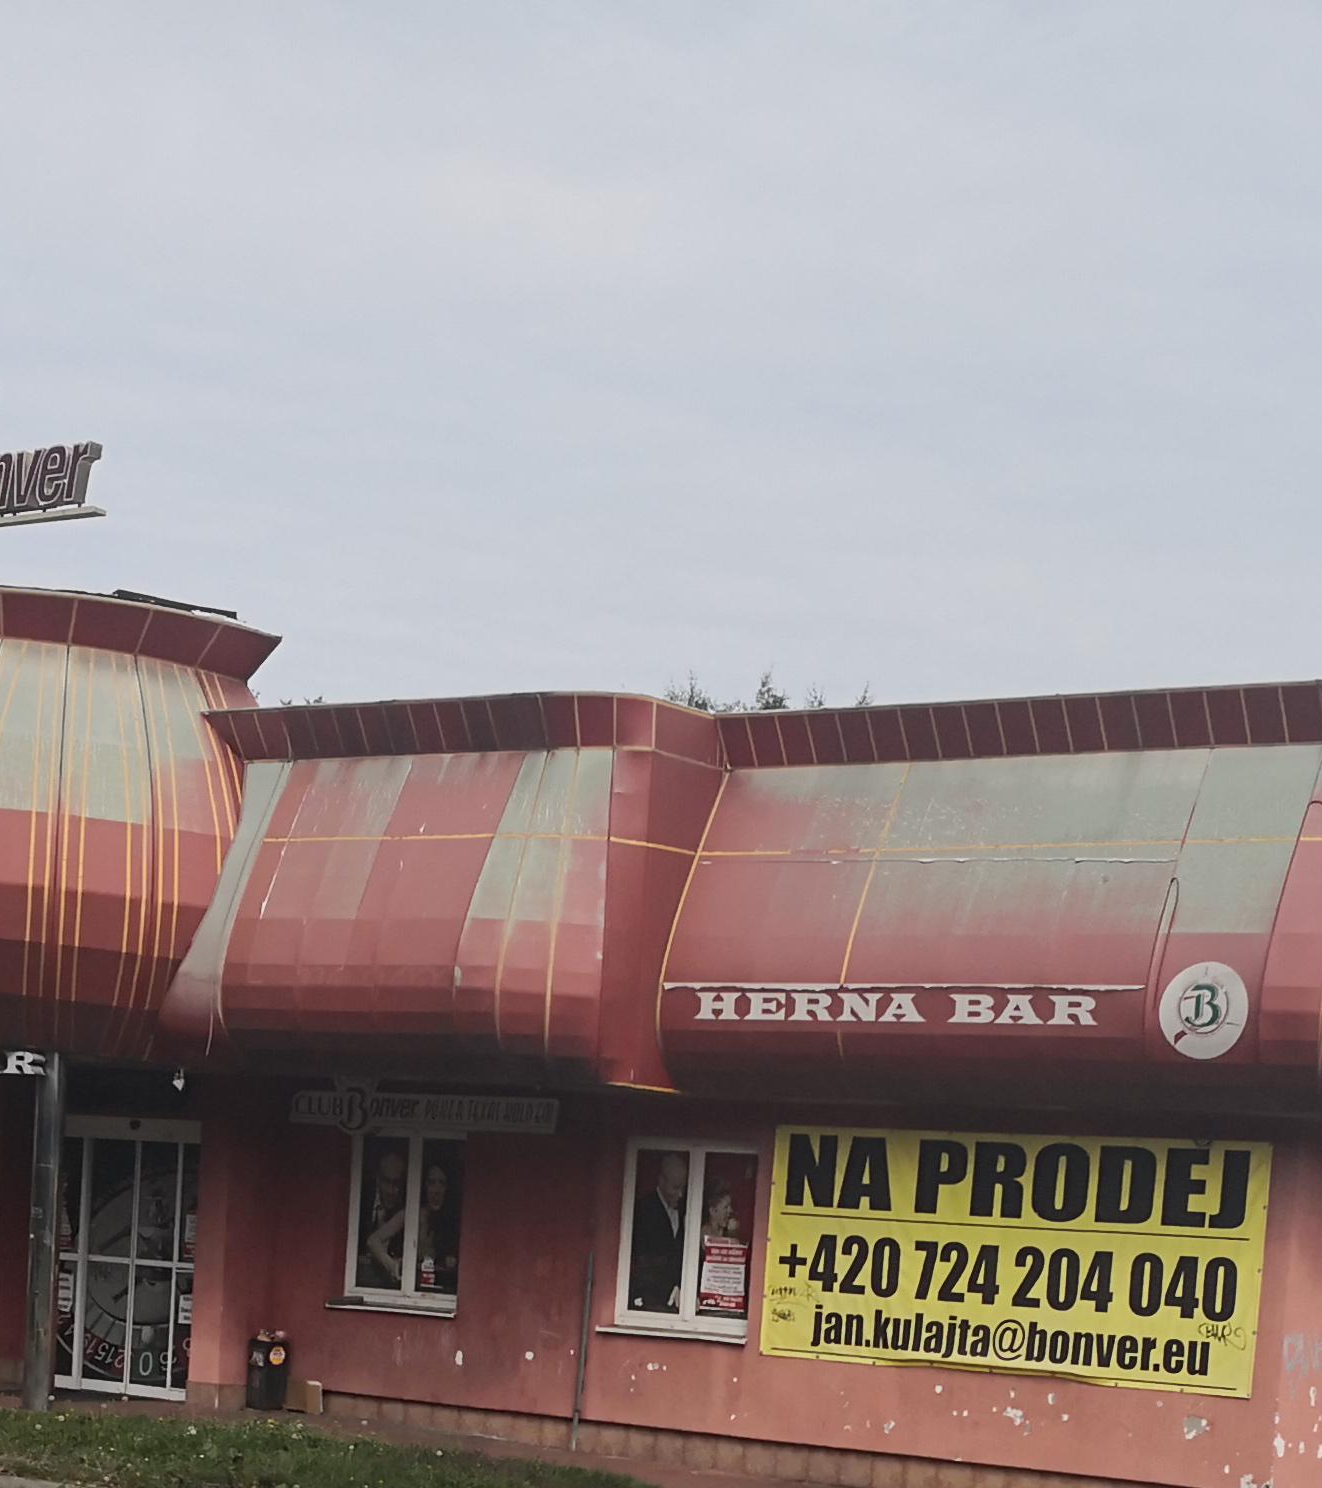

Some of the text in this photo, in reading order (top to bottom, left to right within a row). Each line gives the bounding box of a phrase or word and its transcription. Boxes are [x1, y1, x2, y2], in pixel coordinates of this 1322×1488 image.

[694, 991, 1098, 1026] HERNA BAR
[785, 1133, 1251, 1230] NA PRODEJ
[778, 1234, 901, 1297] +420
[914, 1240, 1000, 1305] 724
[1012, 1246, 1113, 1312] 204
[1128, 1252, 1238, 1321] 040
[811, 1304, 1210, 1376] jan.kulajta@bonver.eu
